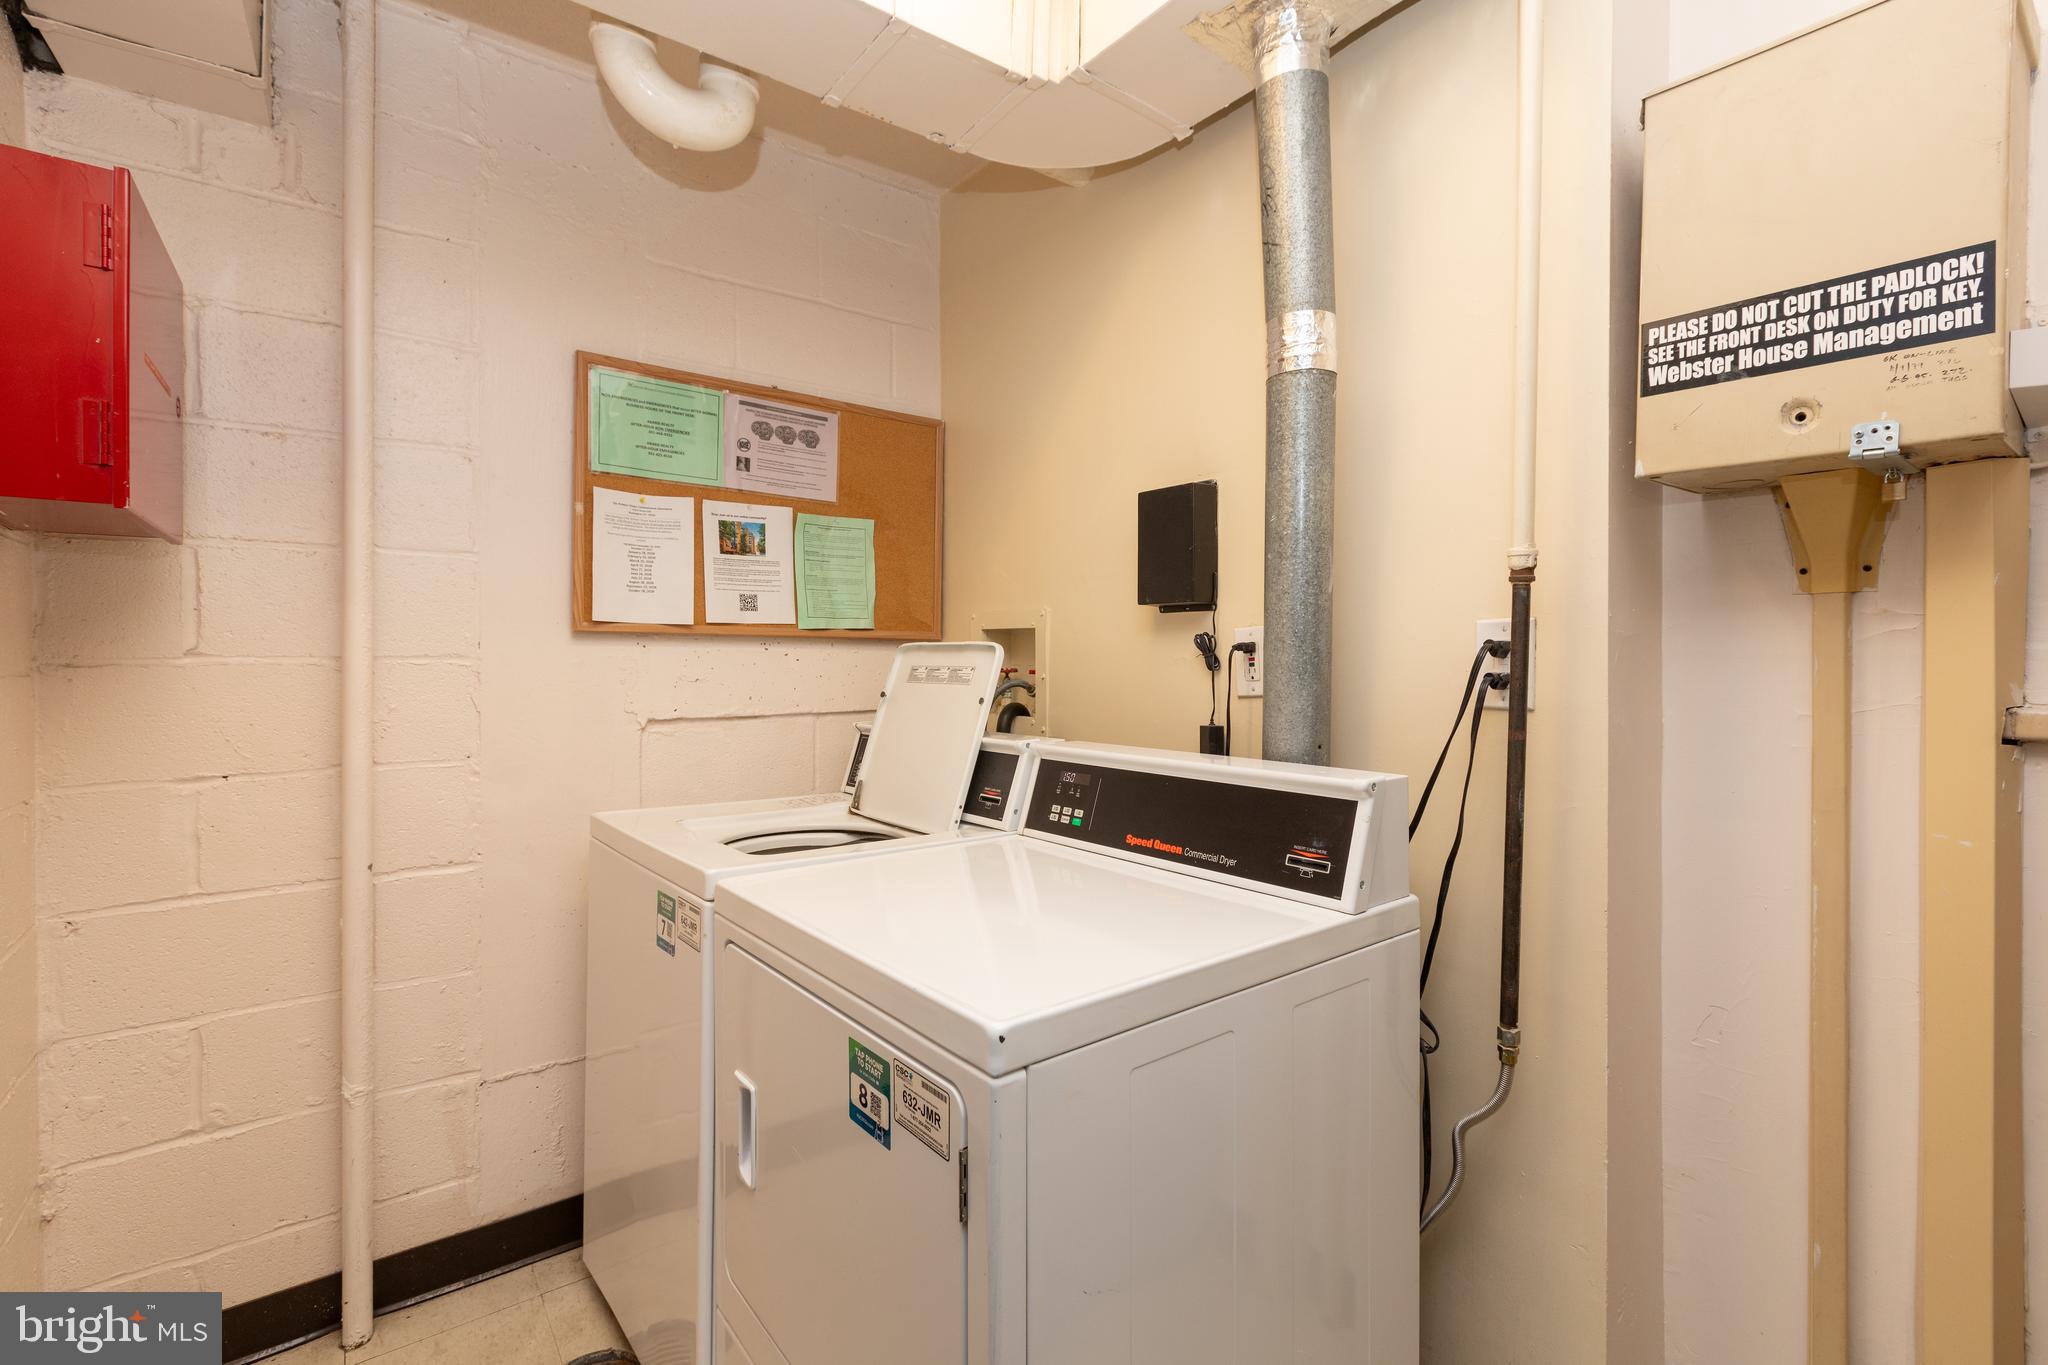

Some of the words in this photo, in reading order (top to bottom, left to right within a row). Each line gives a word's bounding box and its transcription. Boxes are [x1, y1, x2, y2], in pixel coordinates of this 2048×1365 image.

[1648, 315, 1708, 347] PLEASE
[1712, 309, 1738, 333] DO
[1741, 299, 1780, 327] NOT
[1783, 289, 1824, 317] CUT
[1827, 279, 1867, 306] THE
[1871, 251, 1985, 298] PADLOCK!
[1648, 345, 1674, 365] SEE
[1677, 337, 1706, 359] THE
[1709, 325, 1762, 353] FRONT
[1764, 315, 1810, 342] DESK
[1814, 308, 1839, 331] ON
[1843, 297, 1896, 325] DUTY
[1898, 288, 1937, 314] FOR
[1942, 277, 1984, 305] KEY.
[1648, 354, 1735, 387] Webster
[1738, 340, 1808, 370] House
[1813, 301, 1984, 357] Management
[1126, 834, 1153, 848] Speed
[1153, 839, 1183, 855] Queen
[1184, 847, 1219, 863] Commercial
[1219, 855, 1238, 867] Dryer
[661, 919, 666, 936] 7
[855, 1048, 864, 1059] TAP
[865, 1053, 884, 1073] PHONE
[857, 1057, 864, 1068] TO
[865, 1060, 882, 1080] START
[895, 1064, 909, 1078] CSC
[859, 1083, 868, 1109] 8
[902, 1090, 941, 1129] 632-JMR
